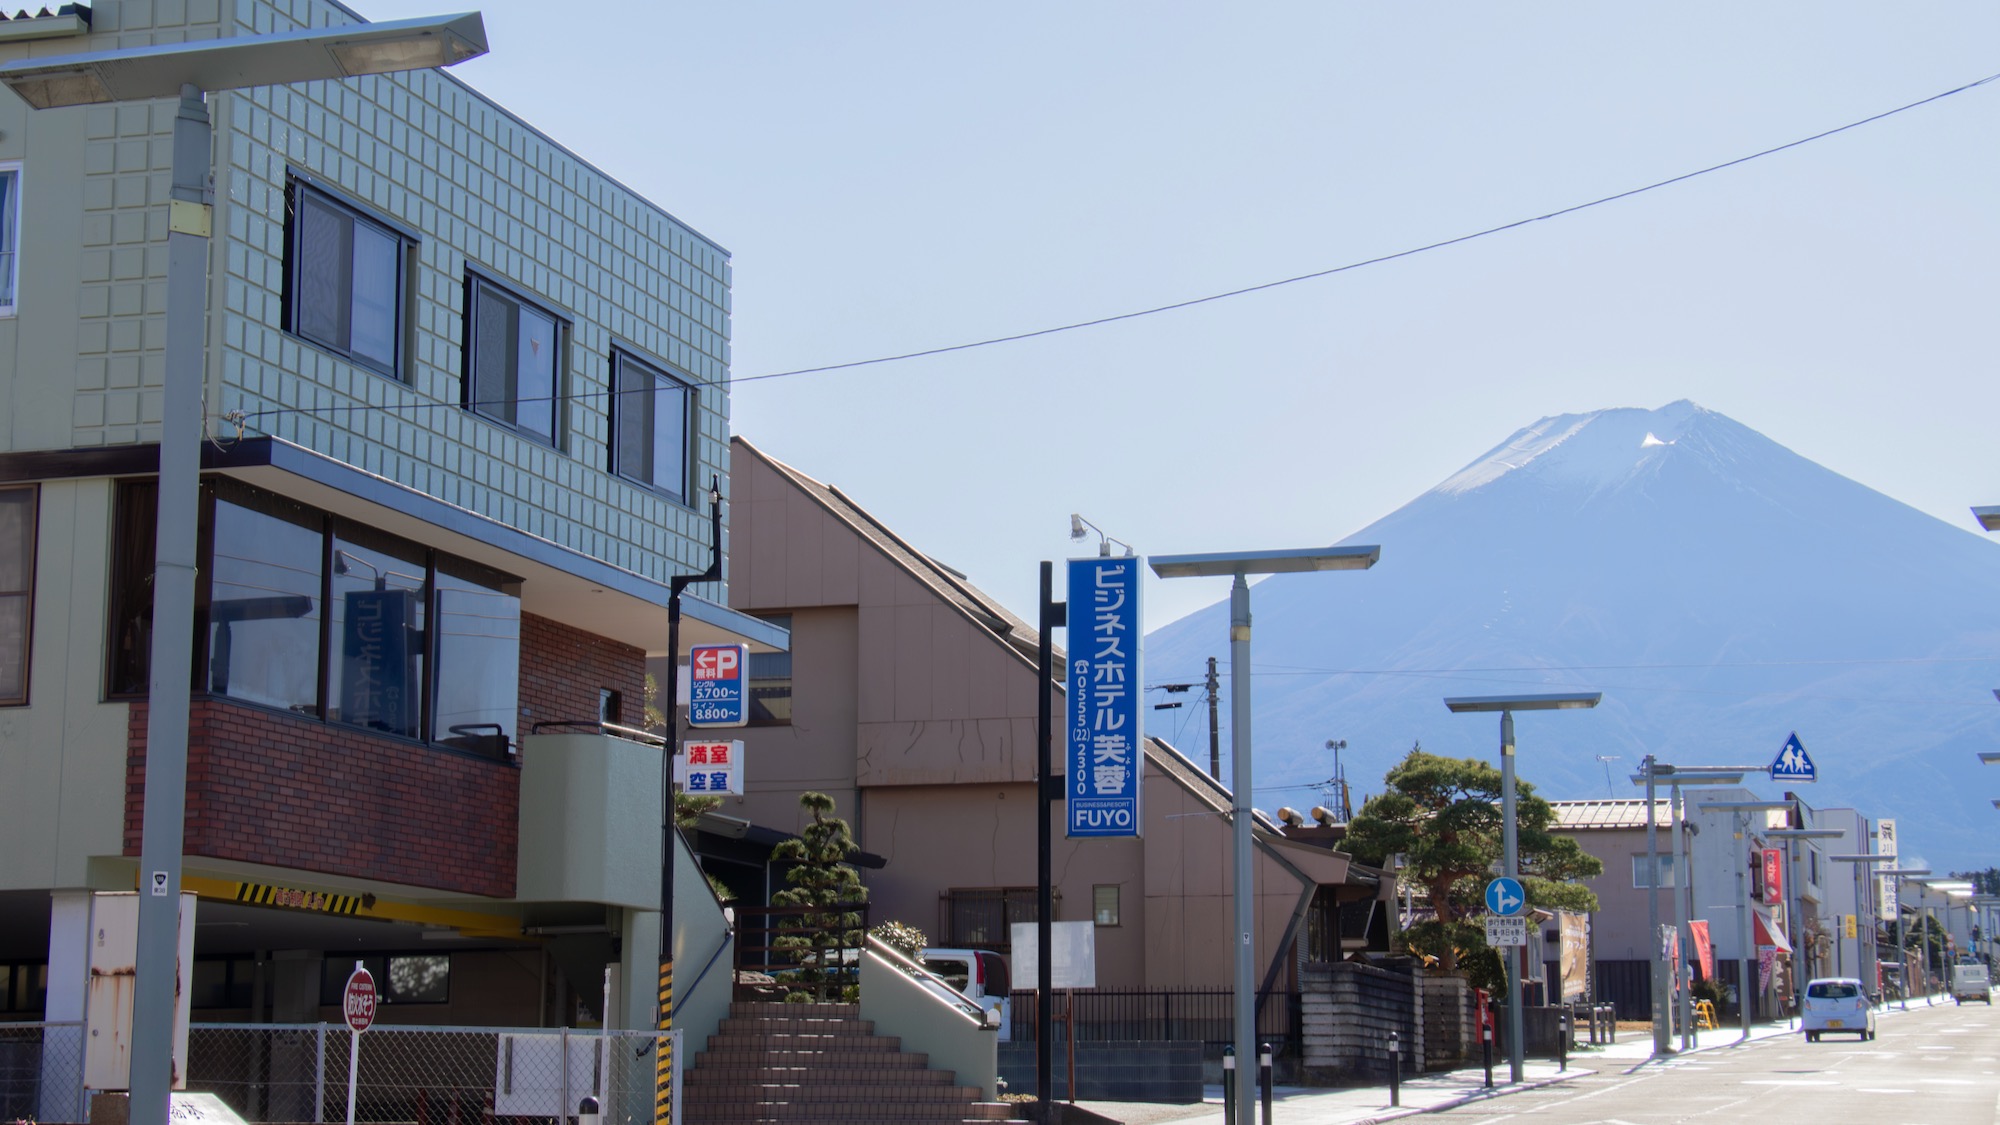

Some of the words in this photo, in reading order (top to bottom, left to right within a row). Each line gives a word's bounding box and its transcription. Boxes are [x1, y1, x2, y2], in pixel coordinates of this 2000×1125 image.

[717, 649, 738, 678] P
[695, 668, 716, 679] 無料
[1093, 565, 1126, 795] ビジネスホテル芙蓉
[689, 745, 728, 764] 満室
[689, 771, 728, 790] 空室
[1075, 808, 1131, 827] FUYO
[1487, 918, 1524, 926] 歩行者用道路
[347, 992, 373, 1017] 防火水そう
